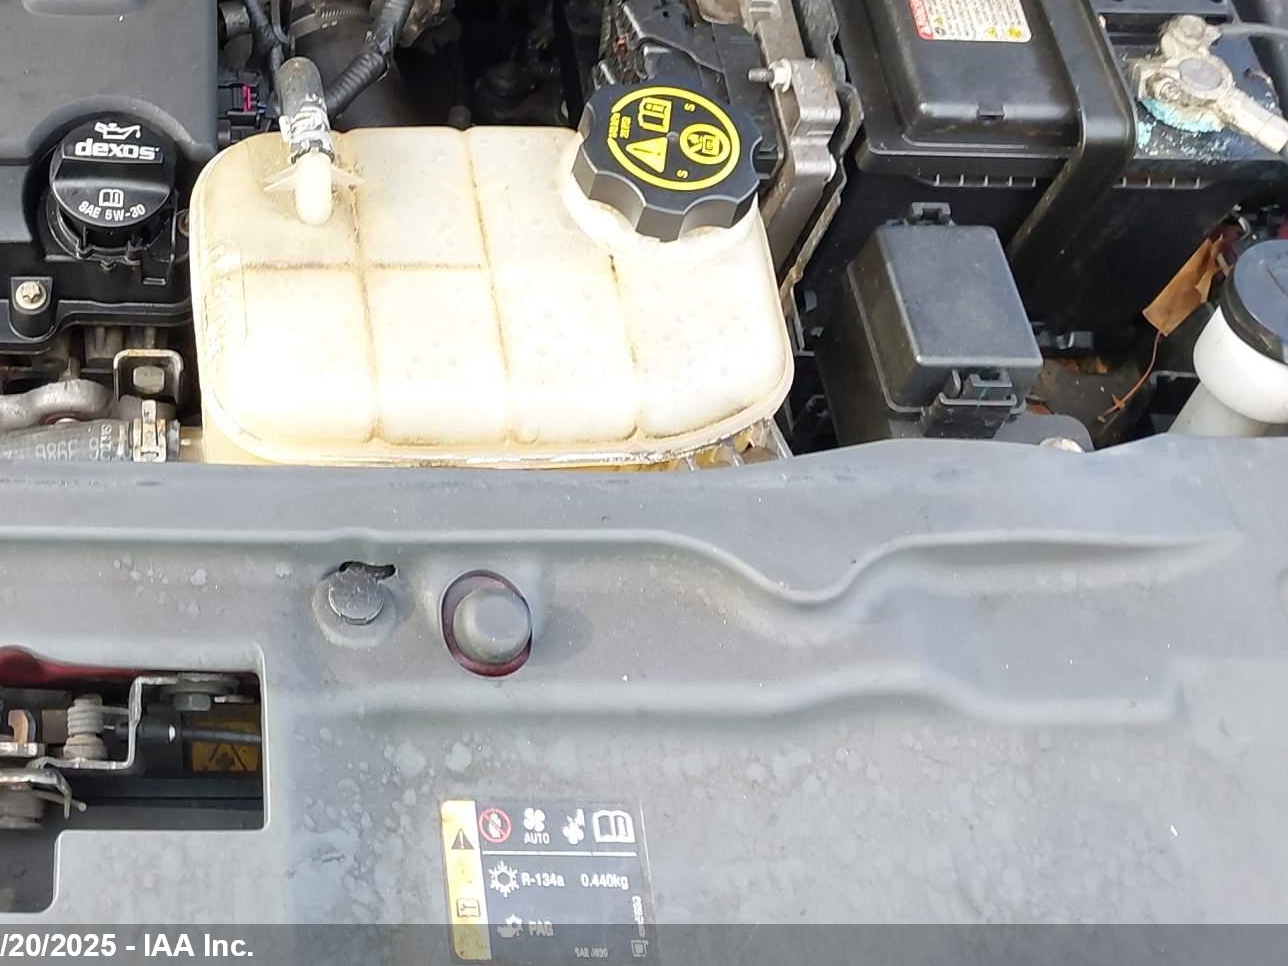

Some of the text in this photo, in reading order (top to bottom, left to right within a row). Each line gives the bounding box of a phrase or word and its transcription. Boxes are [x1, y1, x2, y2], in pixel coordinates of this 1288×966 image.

[74, 137, 156, 161] dexos
[78, 200, 147, 222] SAE 5W-30
[523, 832, 551, 845] AUTO
[520, 871, 629, 891] R-134a 0.440kg
[528, 920, 554, 937] PAG
